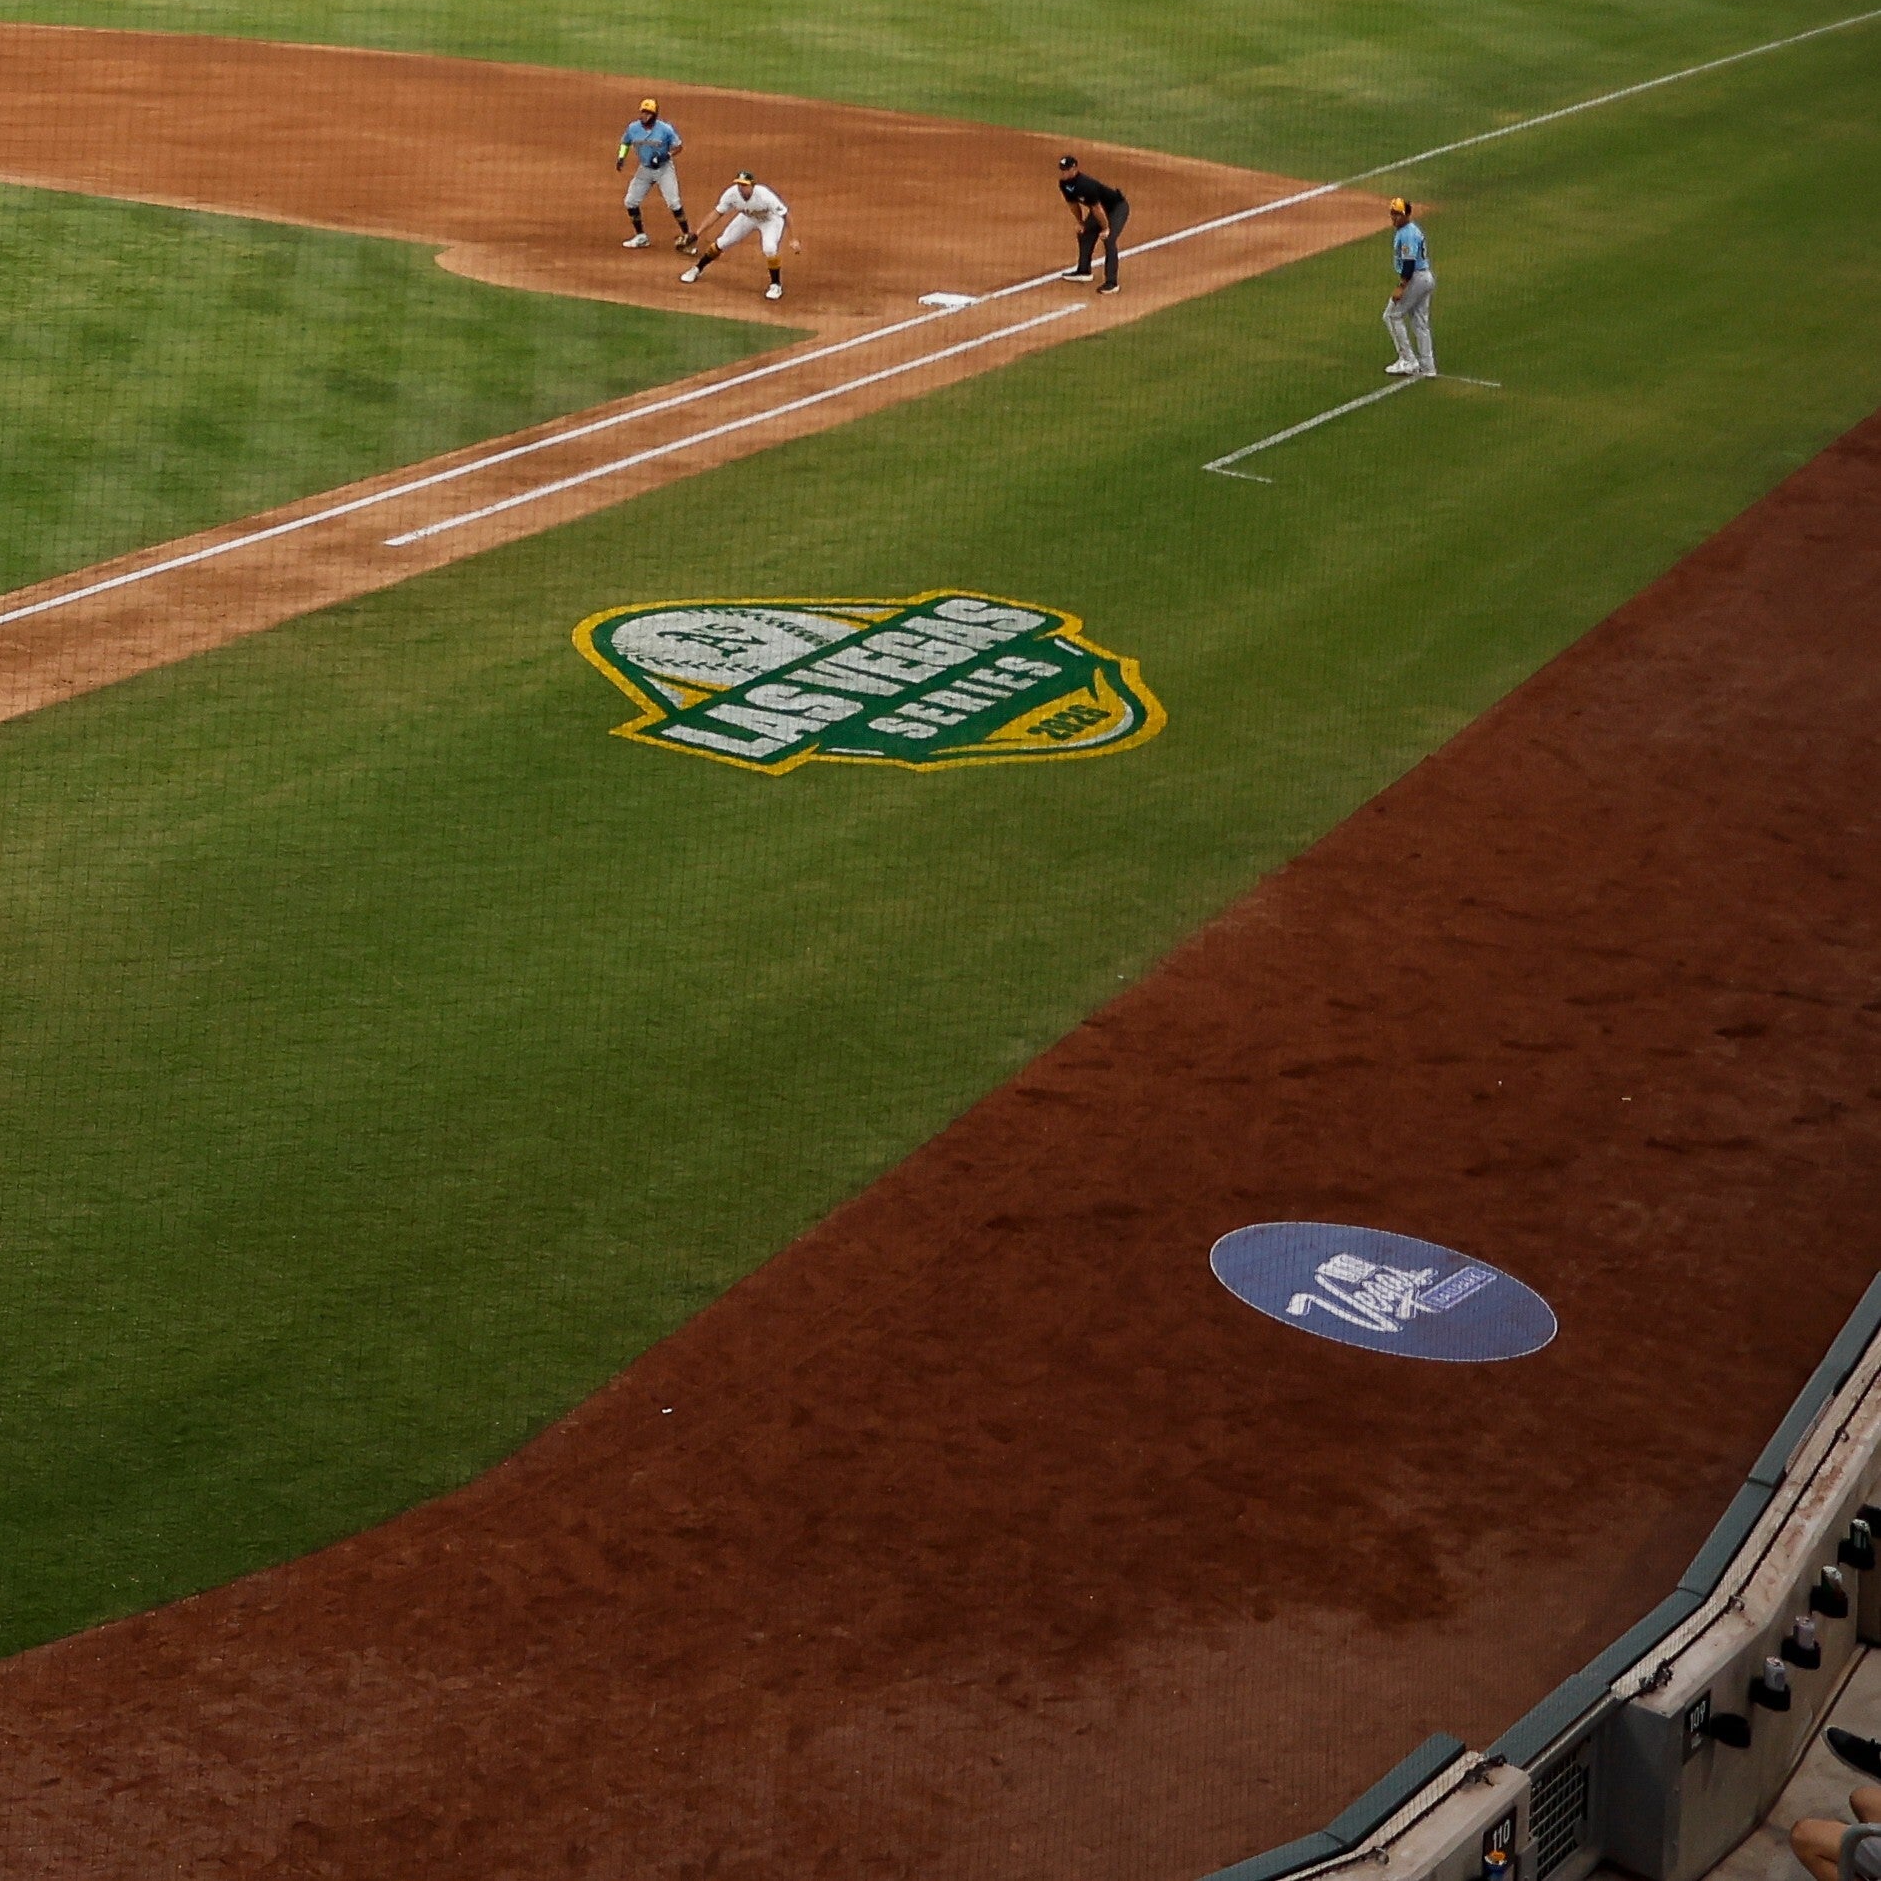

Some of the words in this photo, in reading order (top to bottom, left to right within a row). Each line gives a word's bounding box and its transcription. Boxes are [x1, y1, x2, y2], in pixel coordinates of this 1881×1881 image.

[661, 683, 864, 759] LAS
[814, 598, 1047, 699] VEGAS
[868, 655, 1063, 740] SERIES
[1690, 1699, 1707, 1734] 109
[1492, 1819, 1511, 1850] 110
